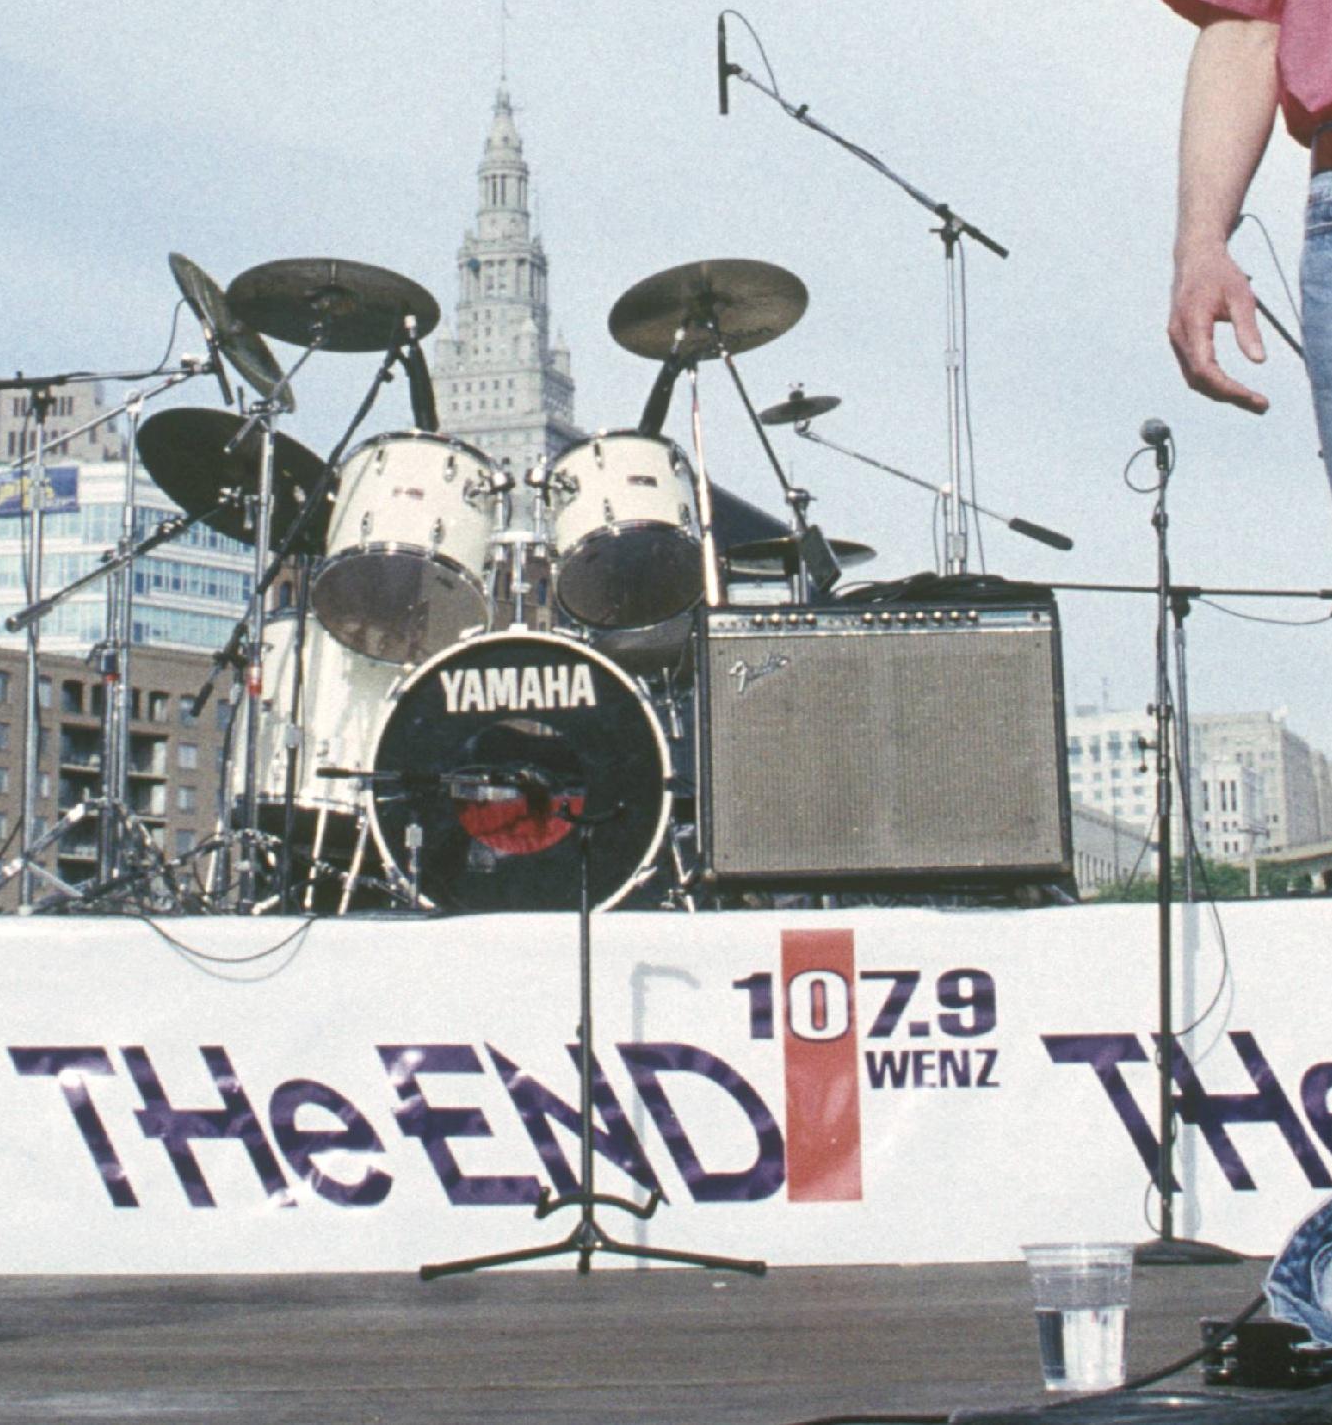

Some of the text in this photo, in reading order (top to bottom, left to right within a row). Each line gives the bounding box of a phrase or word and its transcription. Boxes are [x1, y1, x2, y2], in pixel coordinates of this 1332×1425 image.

[440, 663, 596, 712] YAMAHA
[732, 968, 997, 1043] 107.9
[865, 1049, 1000, 1089] WENZ
